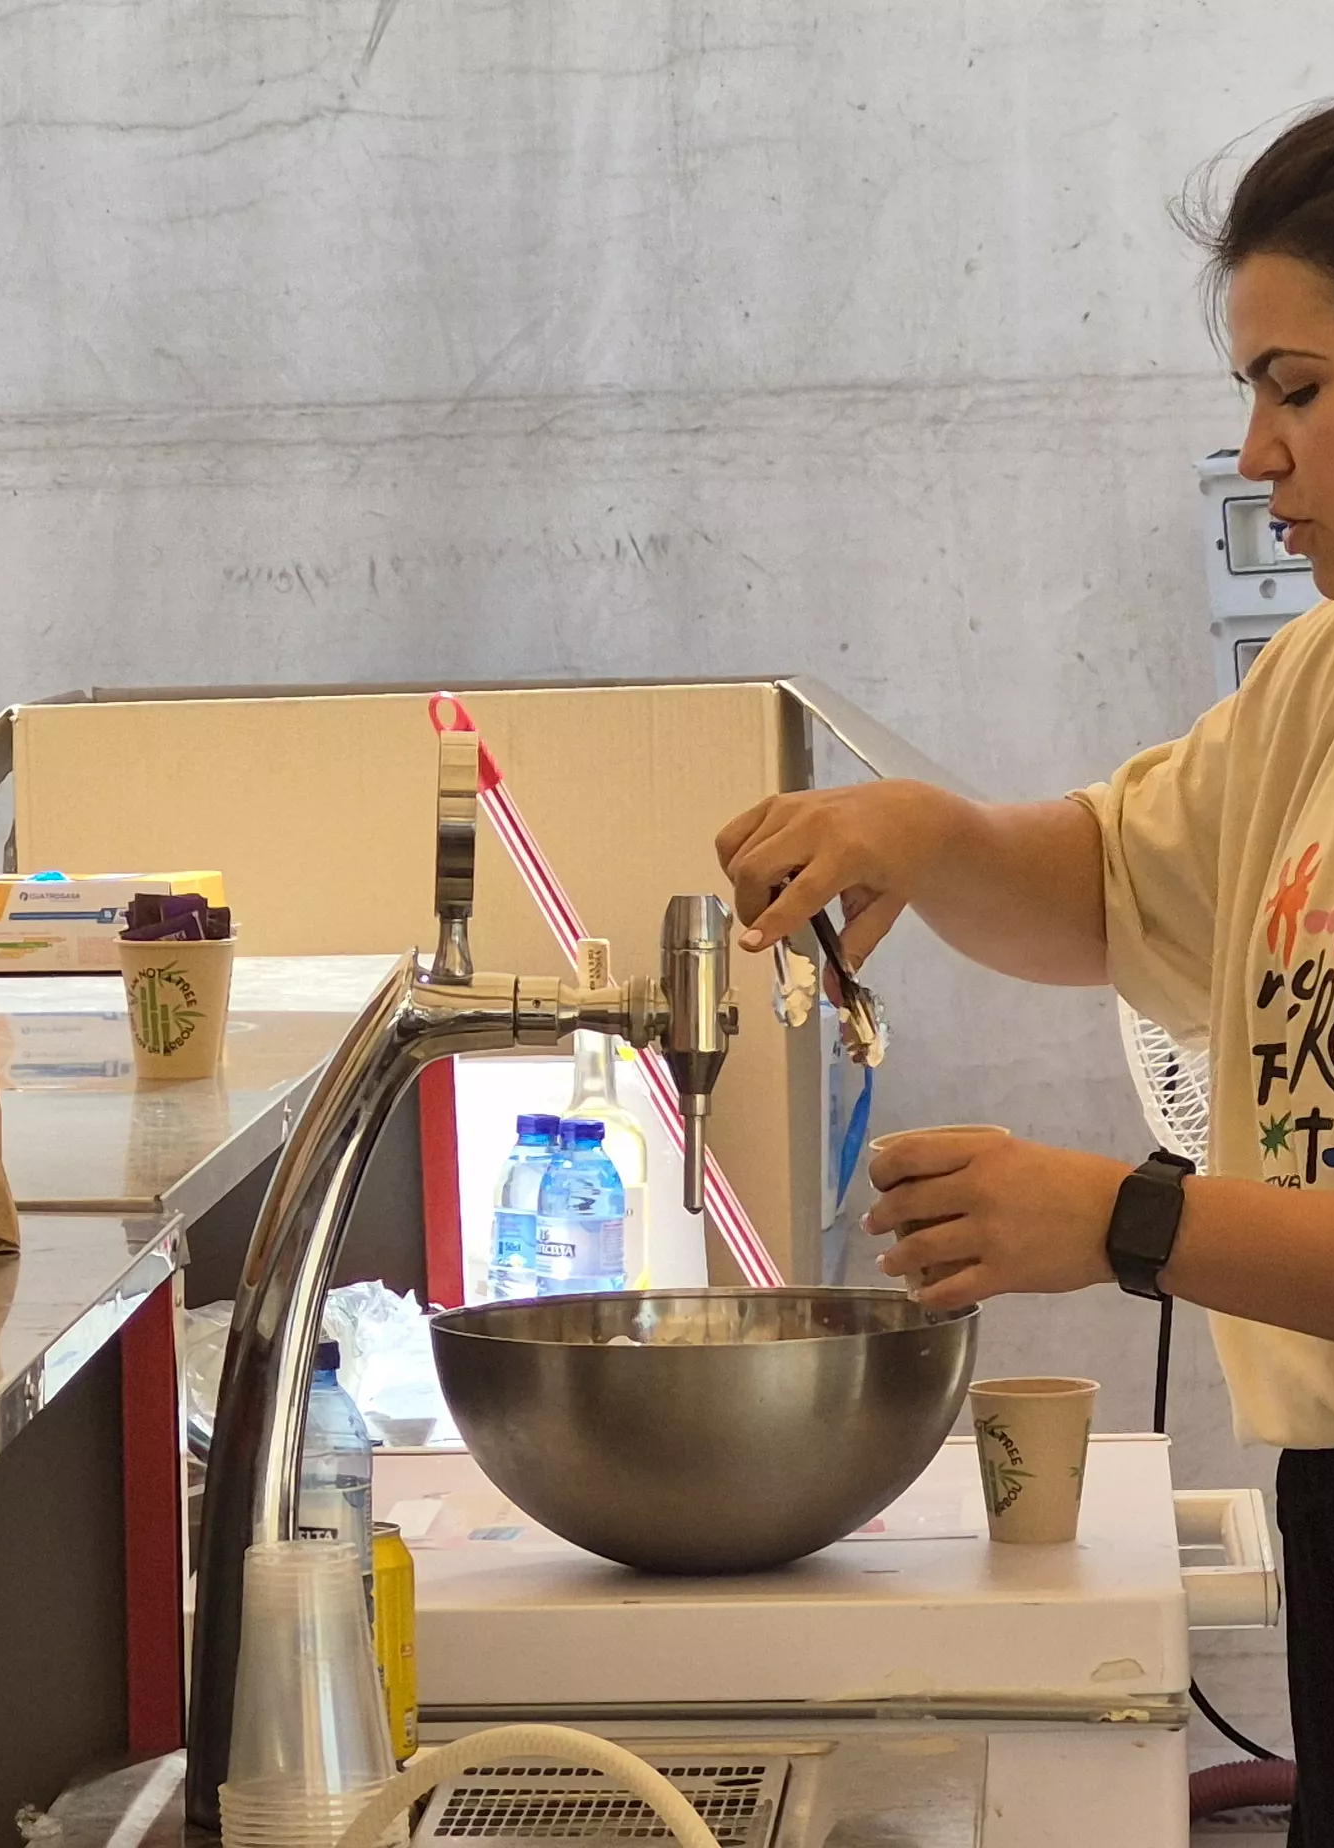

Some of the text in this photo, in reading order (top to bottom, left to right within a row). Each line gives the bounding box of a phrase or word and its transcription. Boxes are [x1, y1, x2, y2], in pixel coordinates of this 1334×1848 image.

[138, 967, 165, 982] NOT
[175, 975, 198, 1009] TREE
[998, 1431, 1024, 1467] TREE
